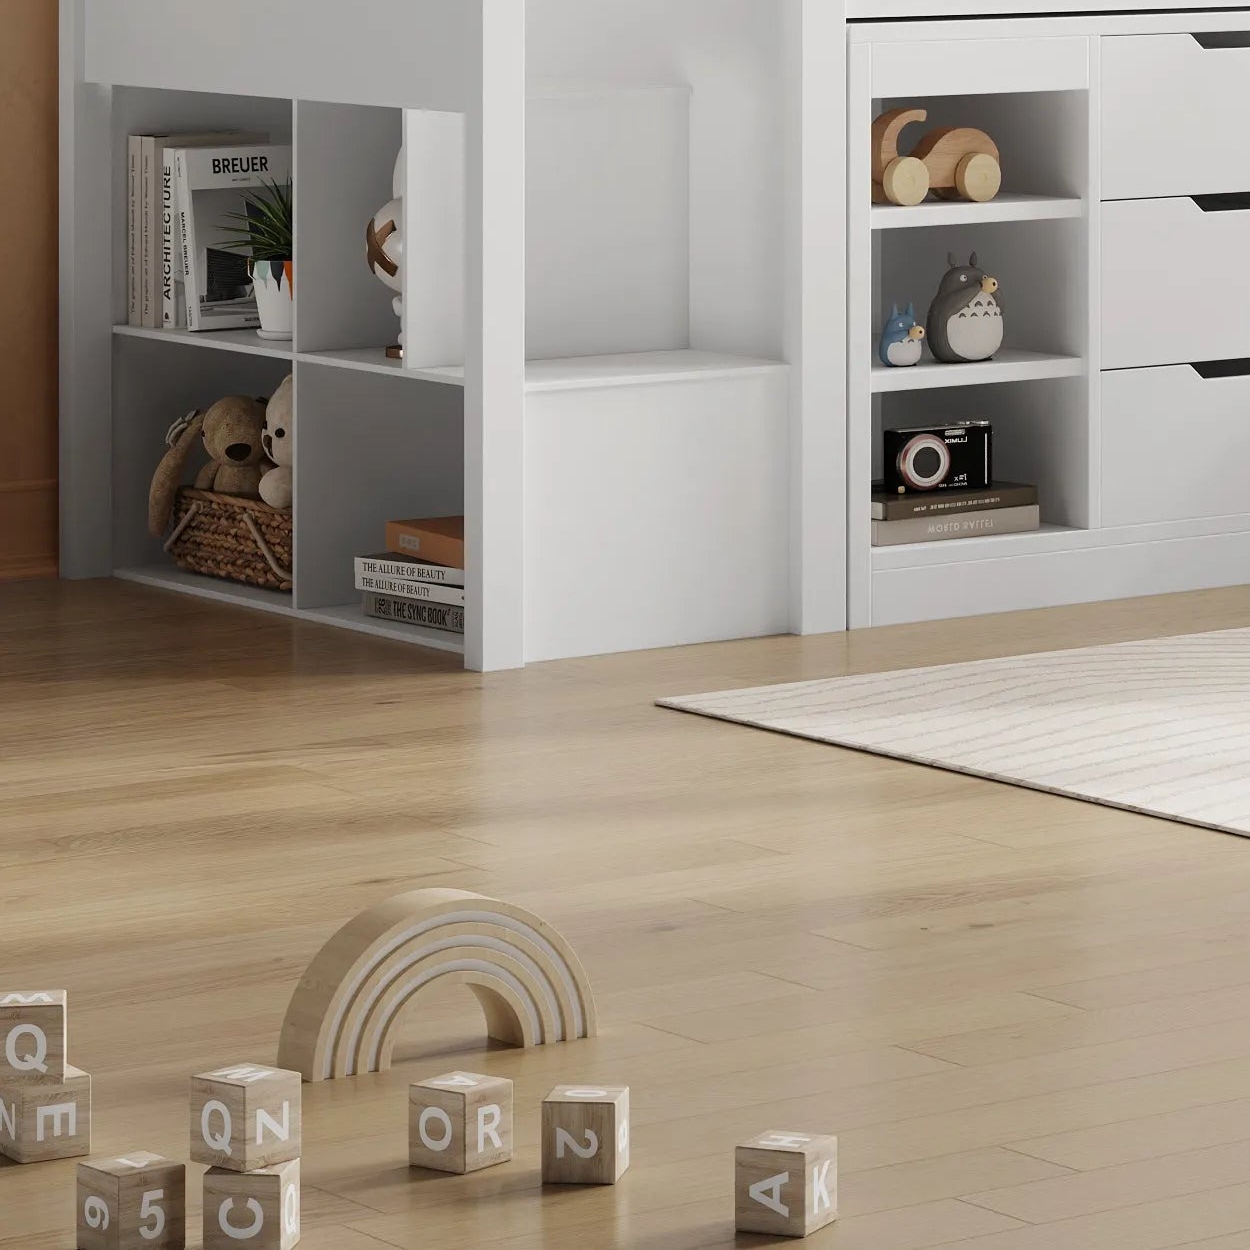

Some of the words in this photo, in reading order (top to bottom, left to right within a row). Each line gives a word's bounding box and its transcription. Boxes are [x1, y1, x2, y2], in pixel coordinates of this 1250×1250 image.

[211, 156, 269, 174] BREUER
[163, 166, 171, 301] ARCHITECTURE
[362, 562, 377, 573] THE
[378, 563, 404, 577] ALLURE
[406, 566, 417, 577] OF
[417, 567, 446, 581] BEAUTY
[362, 577, 374, 588] THE
[374, 579, 397, 593] ALLURE
[397, 582, 406, 593] OF
[406, 583, 431, 597] BEAUTY
[393, 600, 406, 619] THE
[407, 603, 427, 622] SYNC
[5, 1023, 48, 1073] Q
[36, 1102, 77, 1142] E
[201, 1099, 232, 1156] Q
[256, 1100, 290, 1146] N
[477, 1103, 503, 1153] R
[556, 1126, 599, 1159] 2
[748, 1170, 790, 1219] A
[813, 1159, 831, 1215] K
[138, 1188, 165, 1240] 5
[218, 1197, 264, 1239] C
